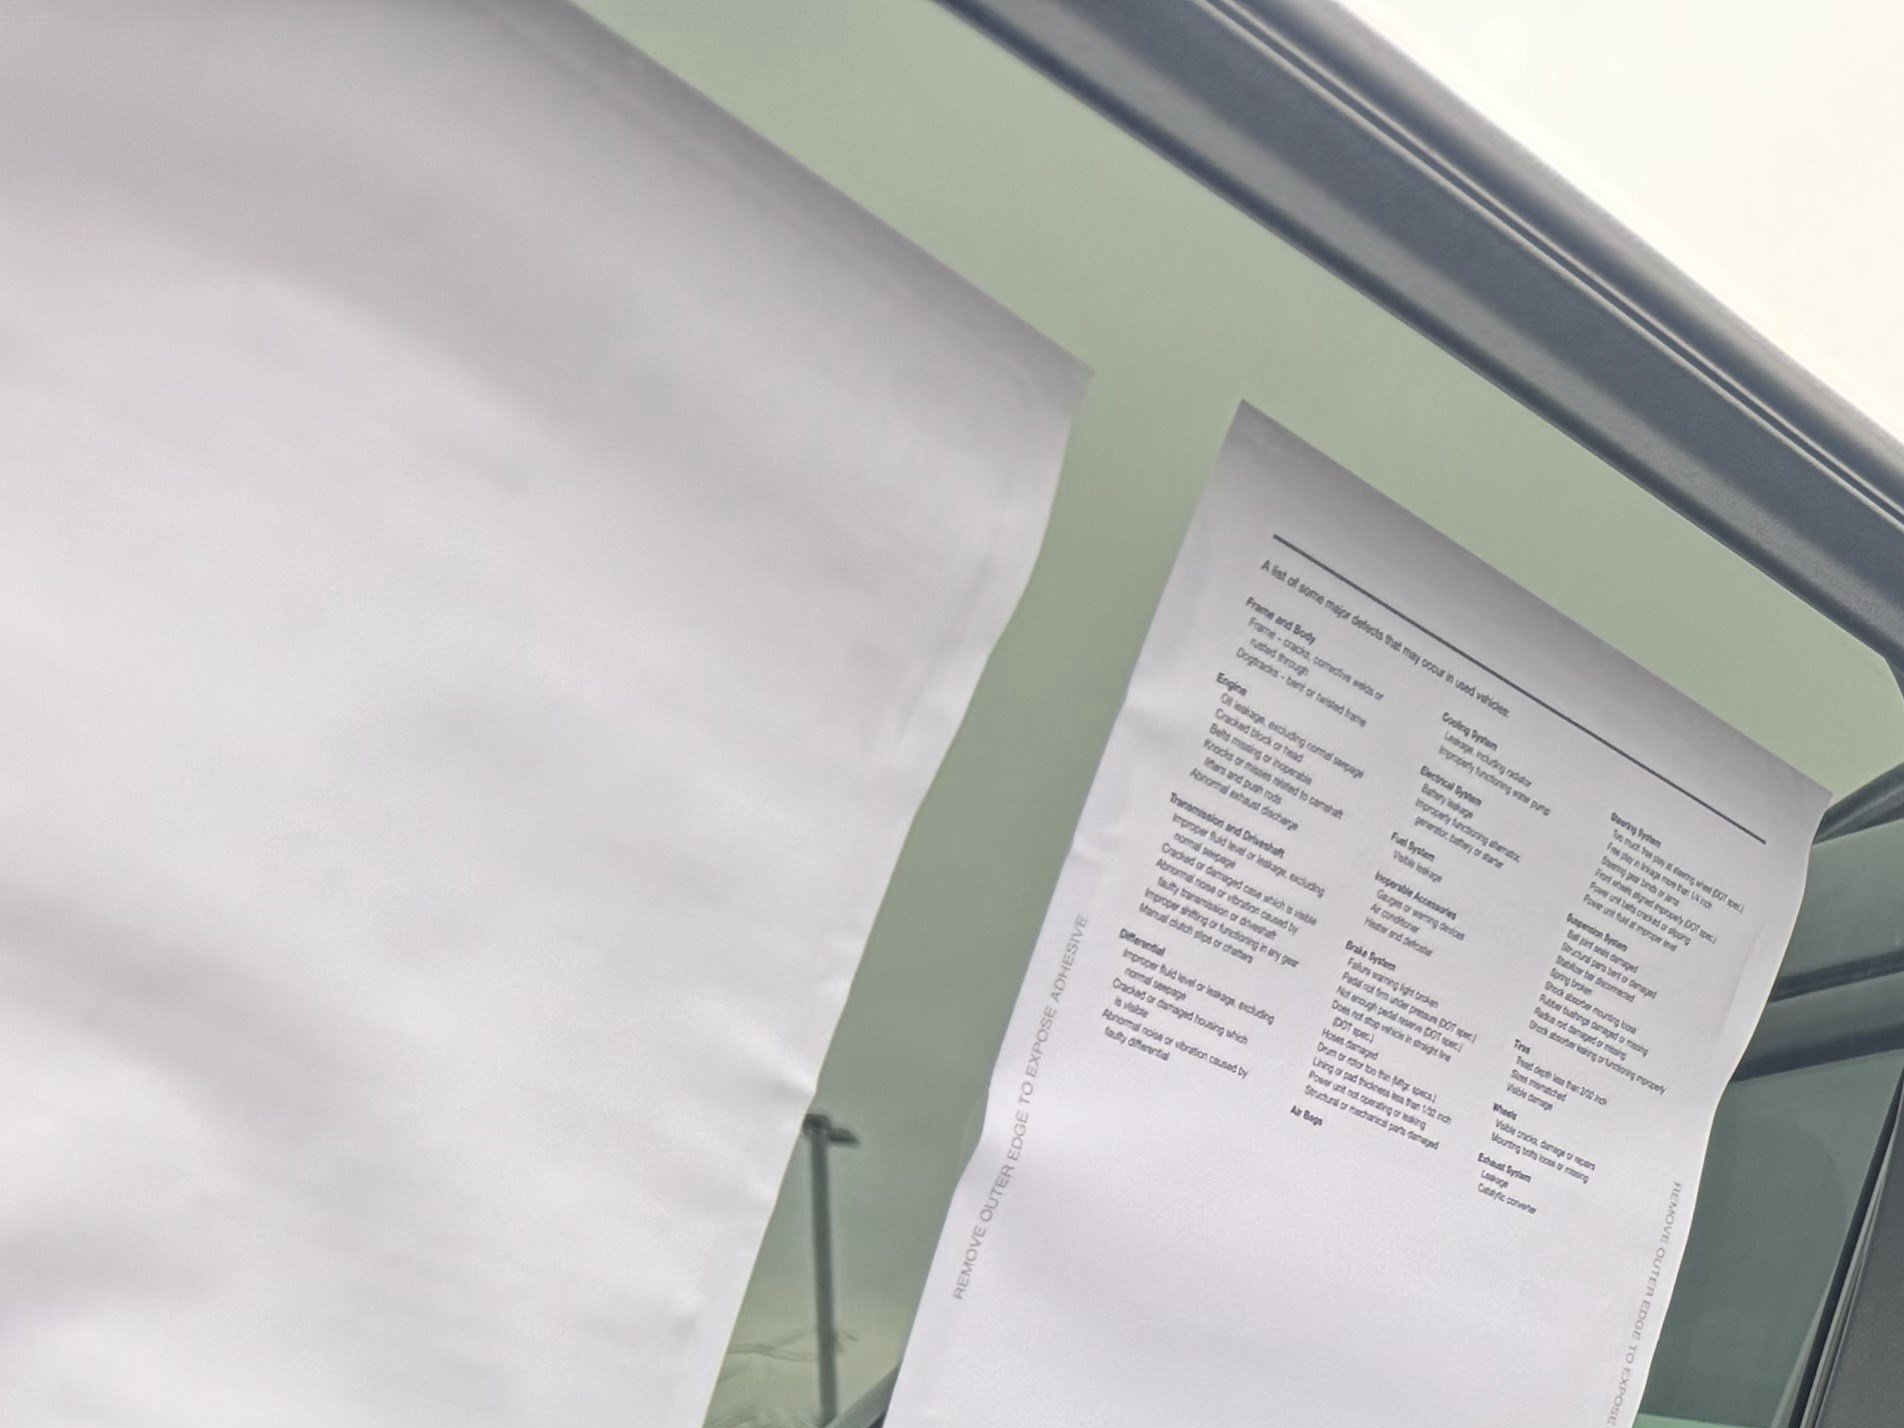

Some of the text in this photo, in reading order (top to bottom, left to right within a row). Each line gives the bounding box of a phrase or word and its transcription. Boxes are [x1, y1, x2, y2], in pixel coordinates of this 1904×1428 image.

[953, 914, 1088, 1300] REMOVE OUTER EDGE TO EXPOSE ADHESIVE
[1660, 1181, 1681, 1243] REMOVE
[1646, 1246, 1665, 1297] OUTER
[1632, 1299, 1651, 1340] EDGE
[1626, 1345, 1637, 1364] TO
[1607, 1366, 1631, 1425] EXPOSE
